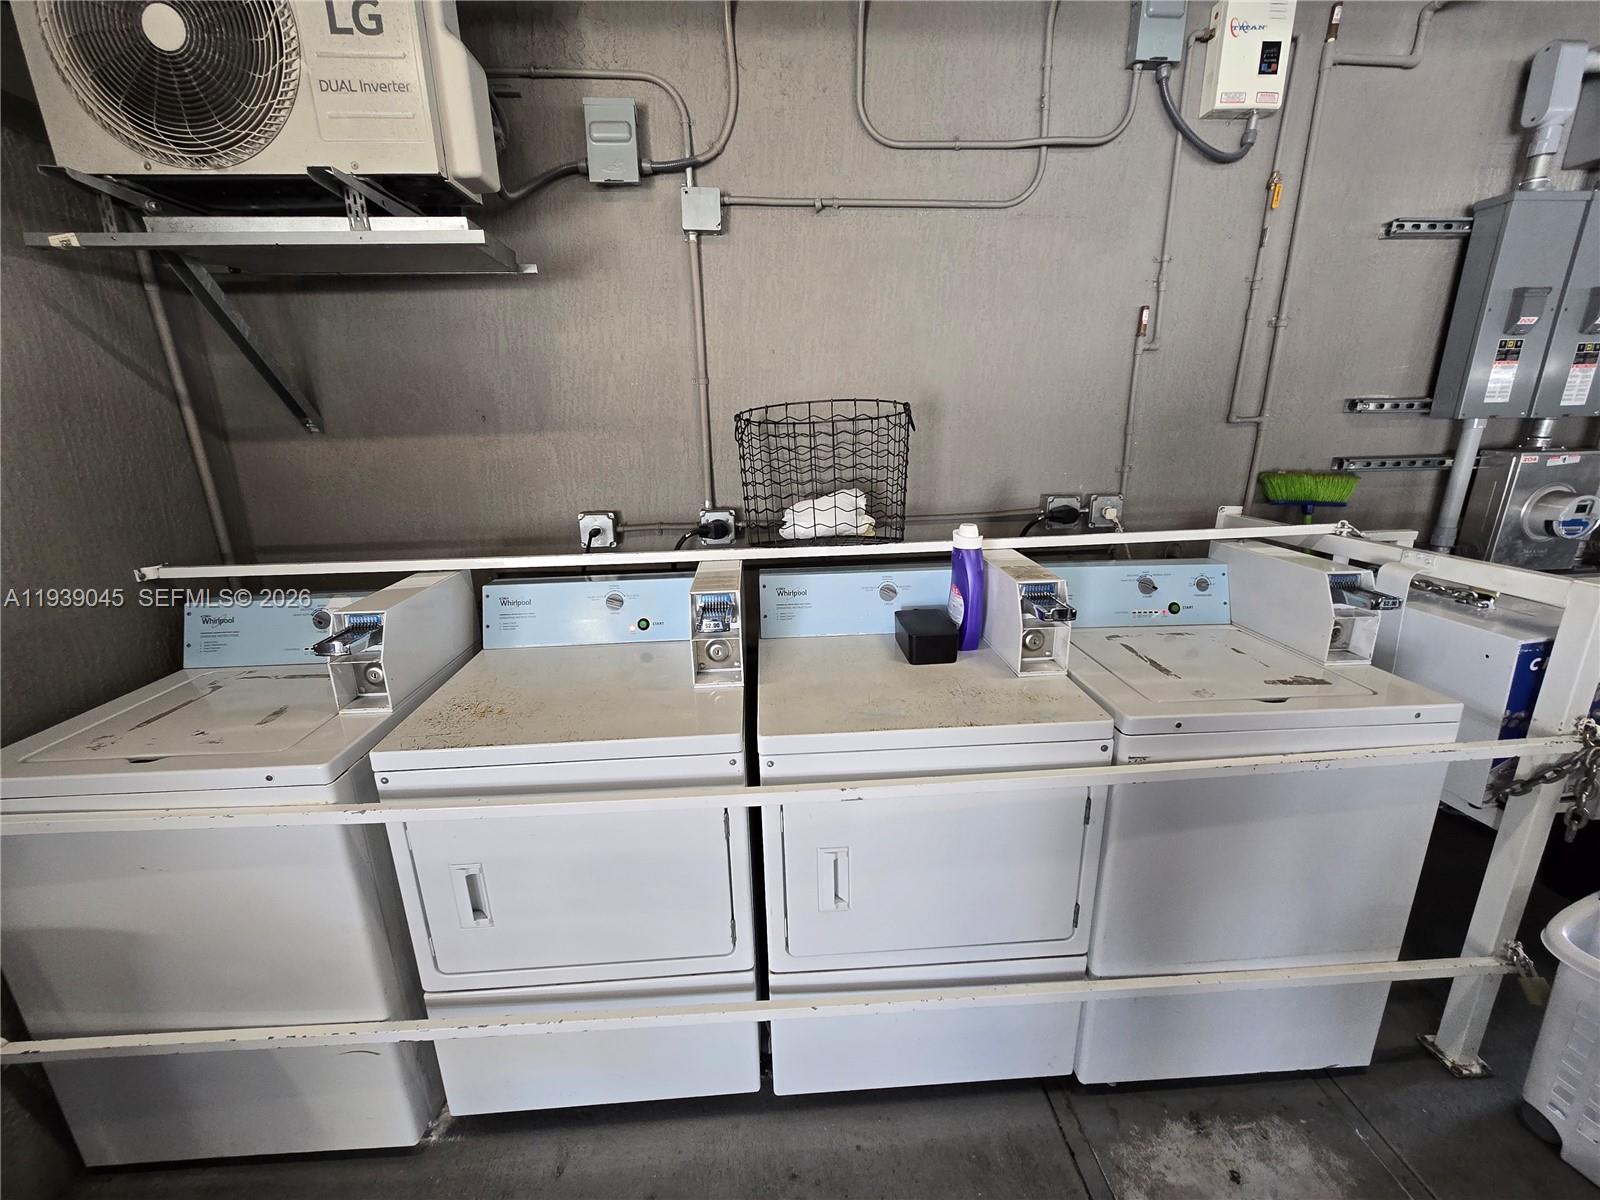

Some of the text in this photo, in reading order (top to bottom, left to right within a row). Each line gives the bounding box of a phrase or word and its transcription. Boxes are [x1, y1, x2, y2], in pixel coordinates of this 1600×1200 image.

[325, 0, 384, 36] LG
[319, 79, 410, 92] DUAL Inverter
[776, 589, 807, 598] Whirlpool
[499, 599, 532, 607] Whirlpool
[201, 616, 235, 625] Whirlpool
